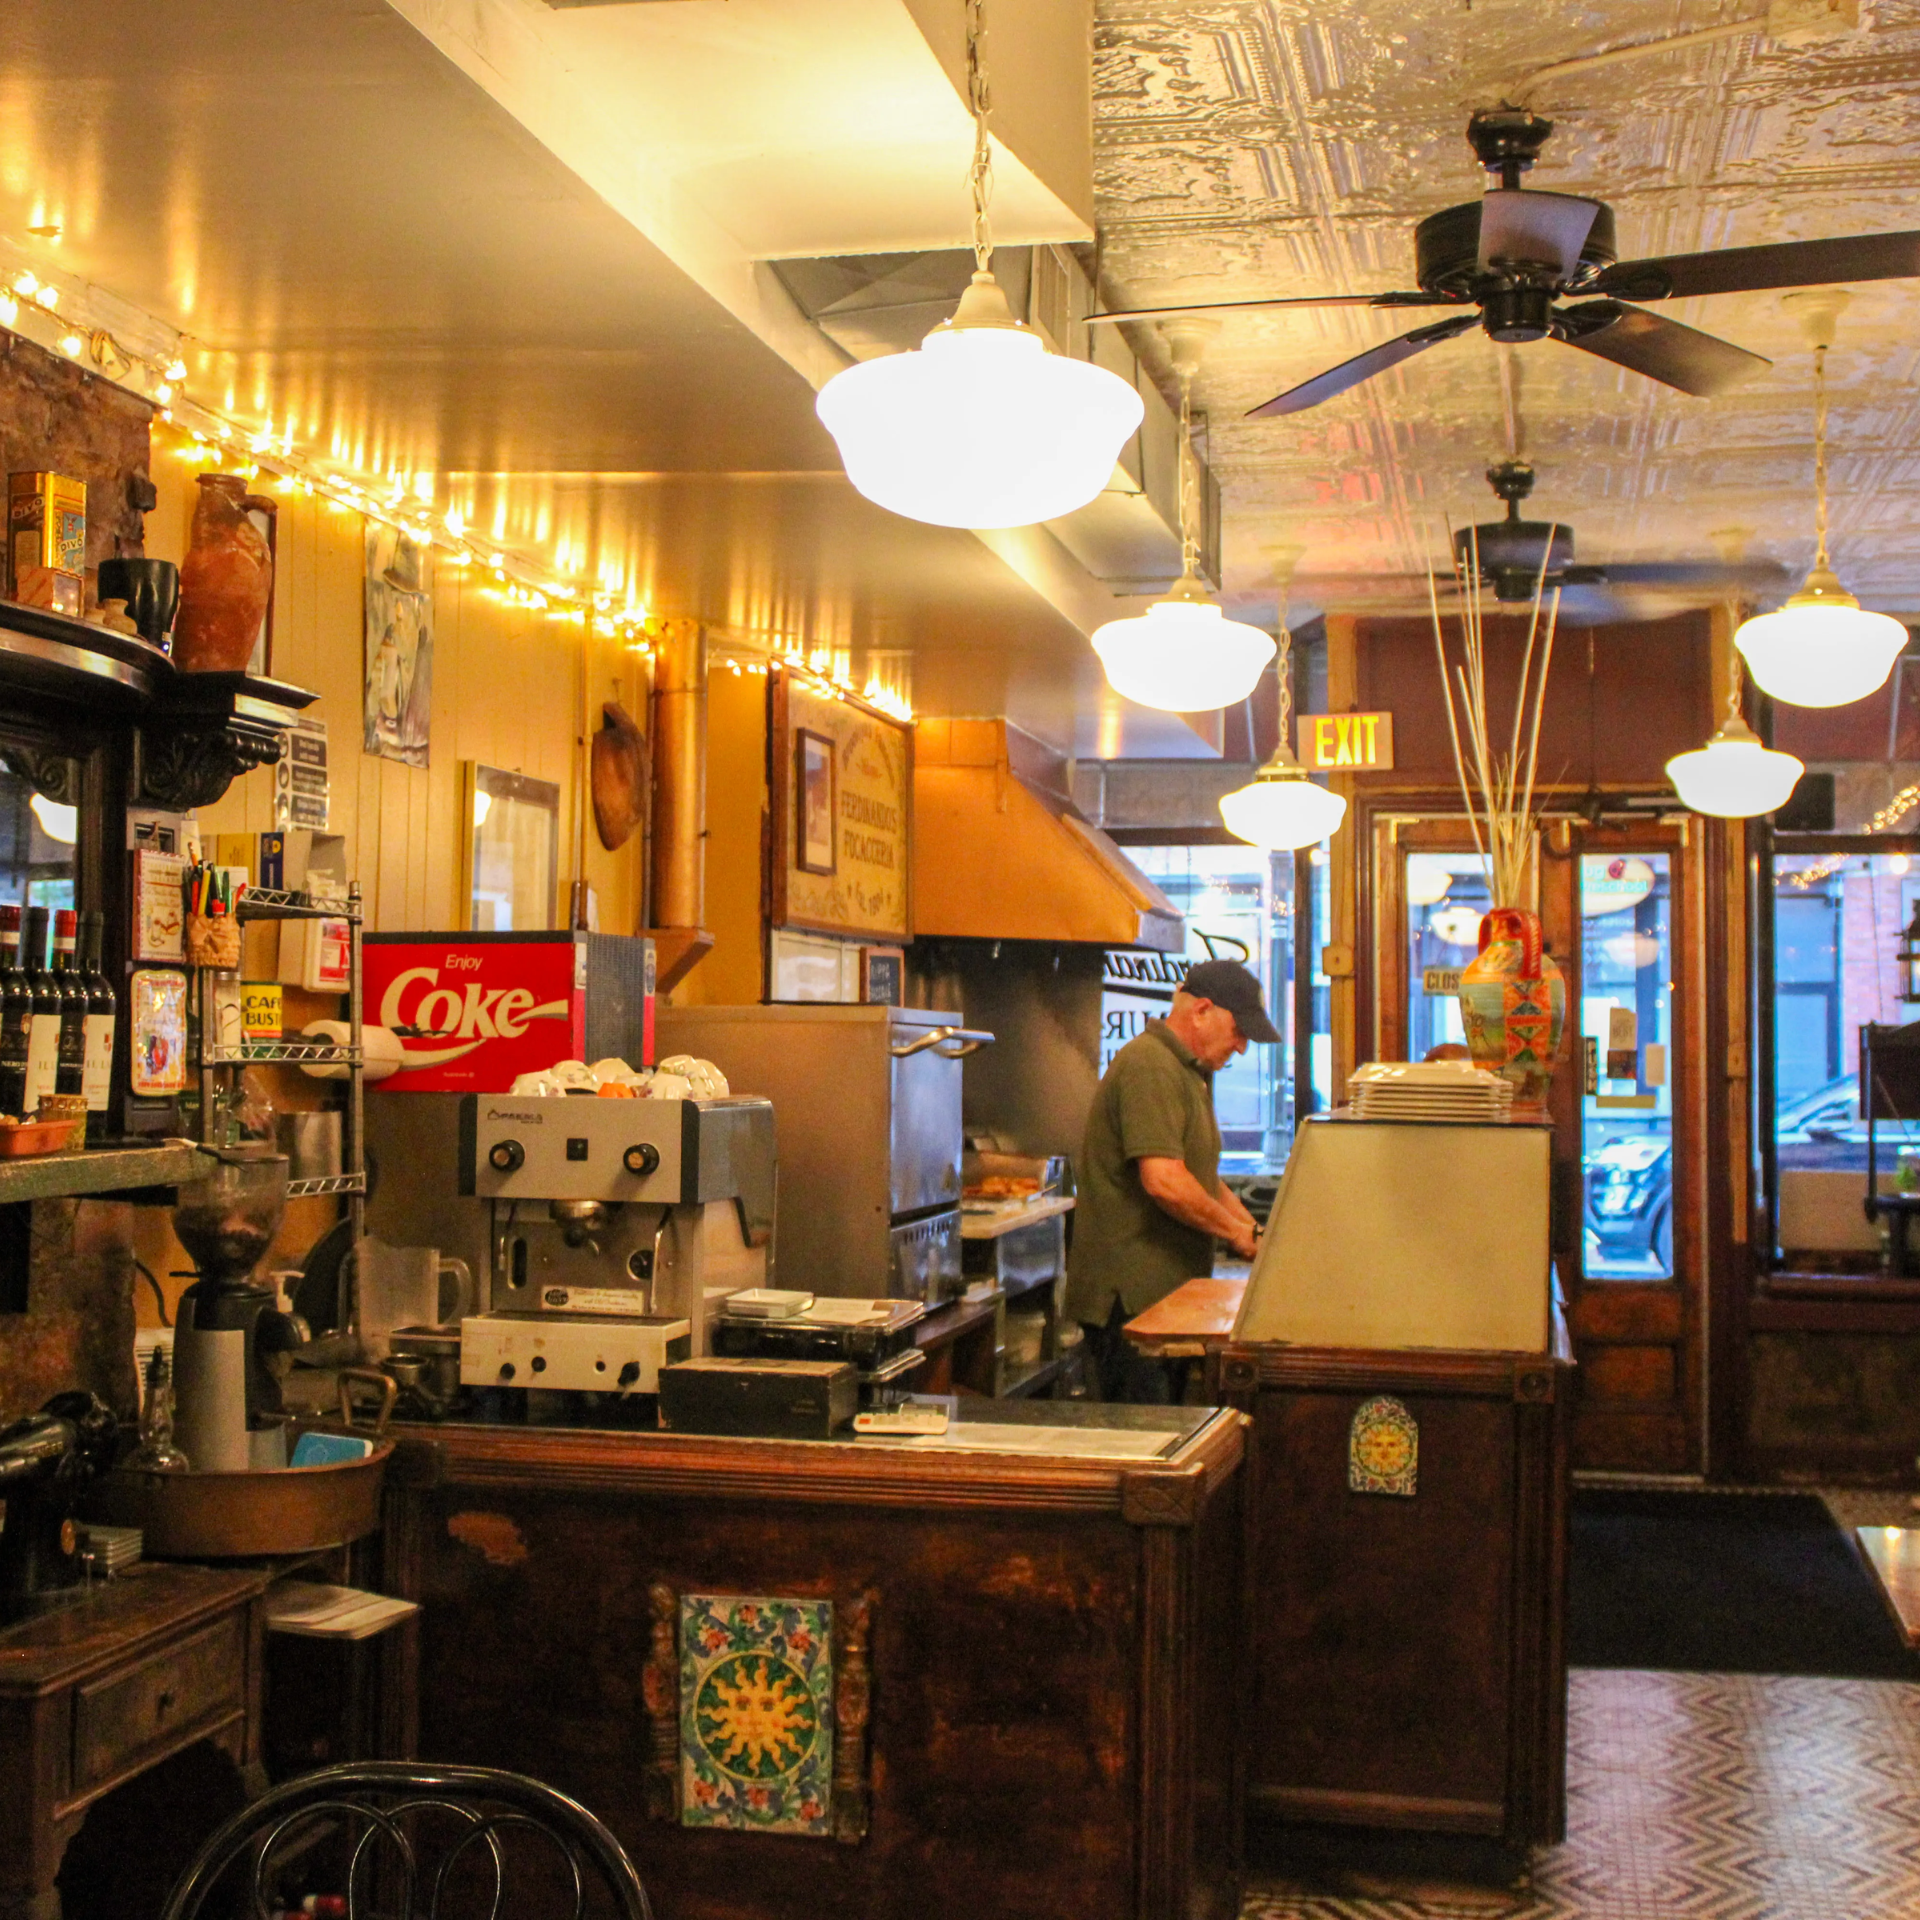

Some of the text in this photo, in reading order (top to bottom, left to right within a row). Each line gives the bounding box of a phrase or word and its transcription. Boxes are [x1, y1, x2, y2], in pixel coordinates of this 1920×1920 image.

[14, 498, 42, 517] DIVO
[60, 538, 83, 552] DIVO
[1315, 715, 1379, 767] EXIT
[445, 954, 483, 971] Enjoy
[1427, 972, 1459, 990] CLOS
[380, 967, 534, 1039] Coke
